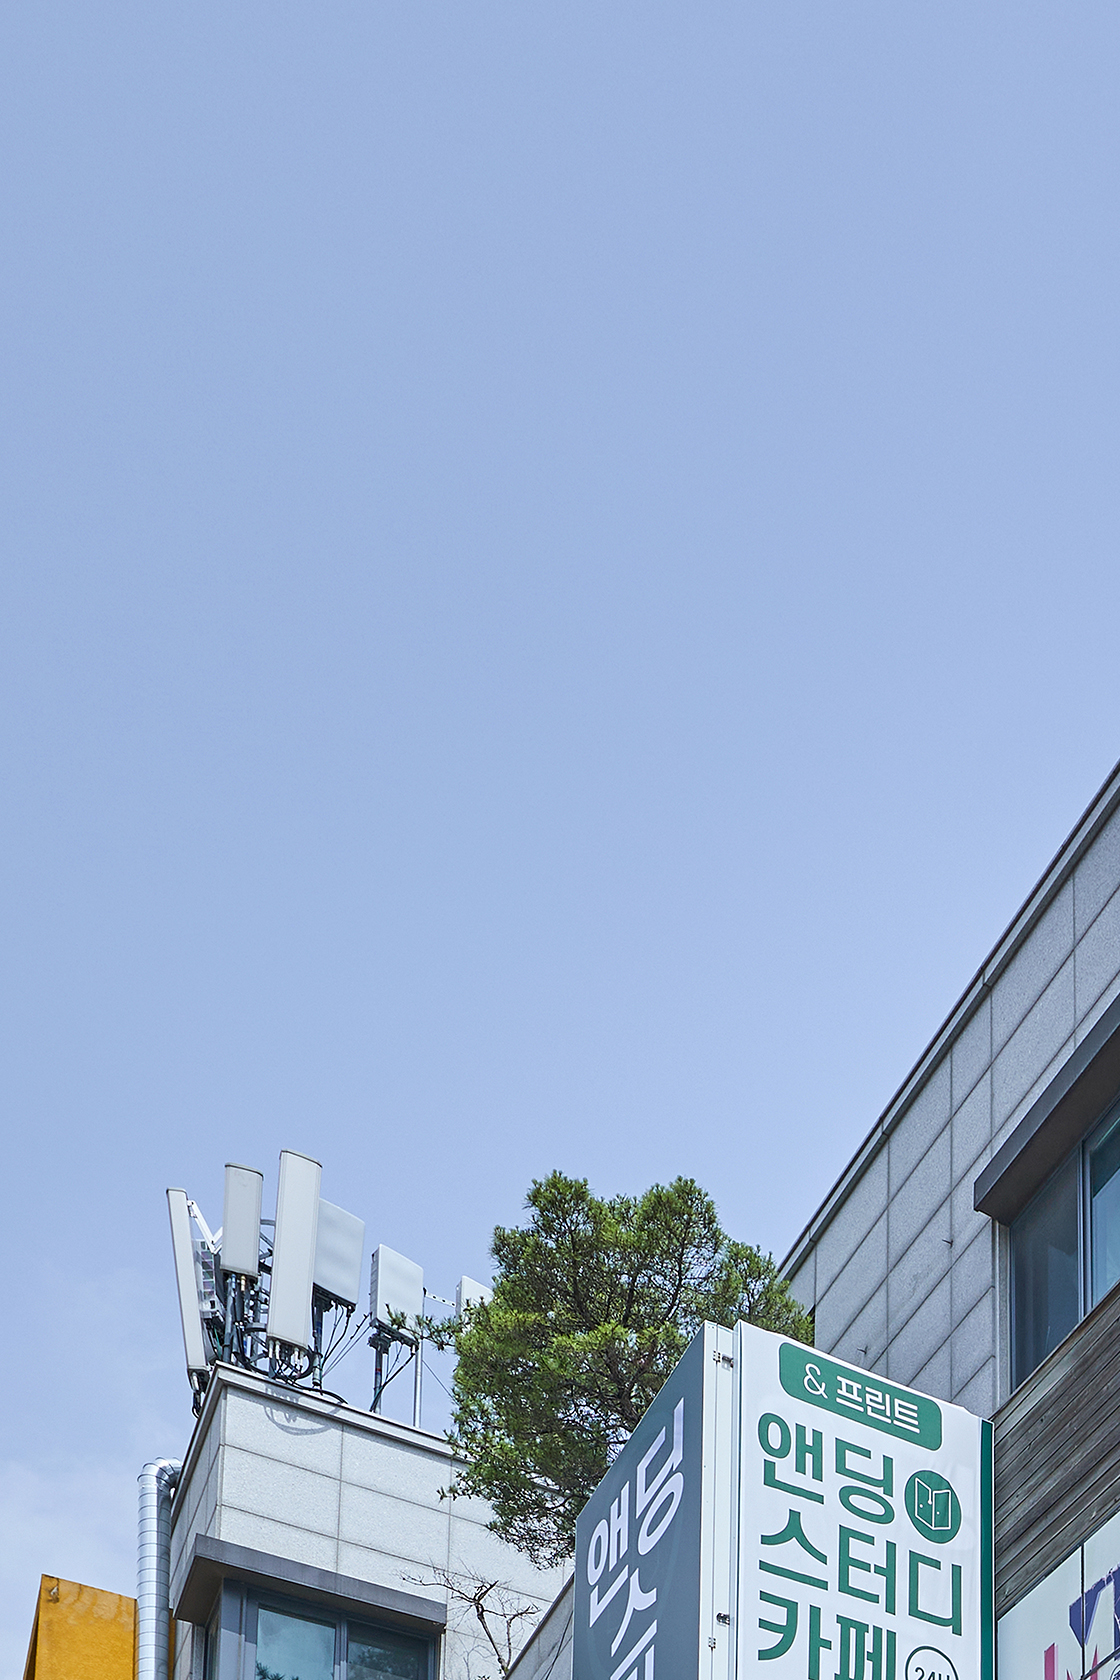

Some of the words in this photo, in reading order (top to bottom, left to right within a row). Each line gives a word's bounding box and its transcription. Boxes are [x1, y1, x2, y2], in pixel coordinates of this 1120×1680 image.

[803, 1363, 828, 1399] &
[836, 1375, 920, 1434] 프린트
[586, 1397, 685, 1629] 앤딩
[757, 1412, 896, 1525] 앤딩
[758, 1507, 963, 1637] 스터디
